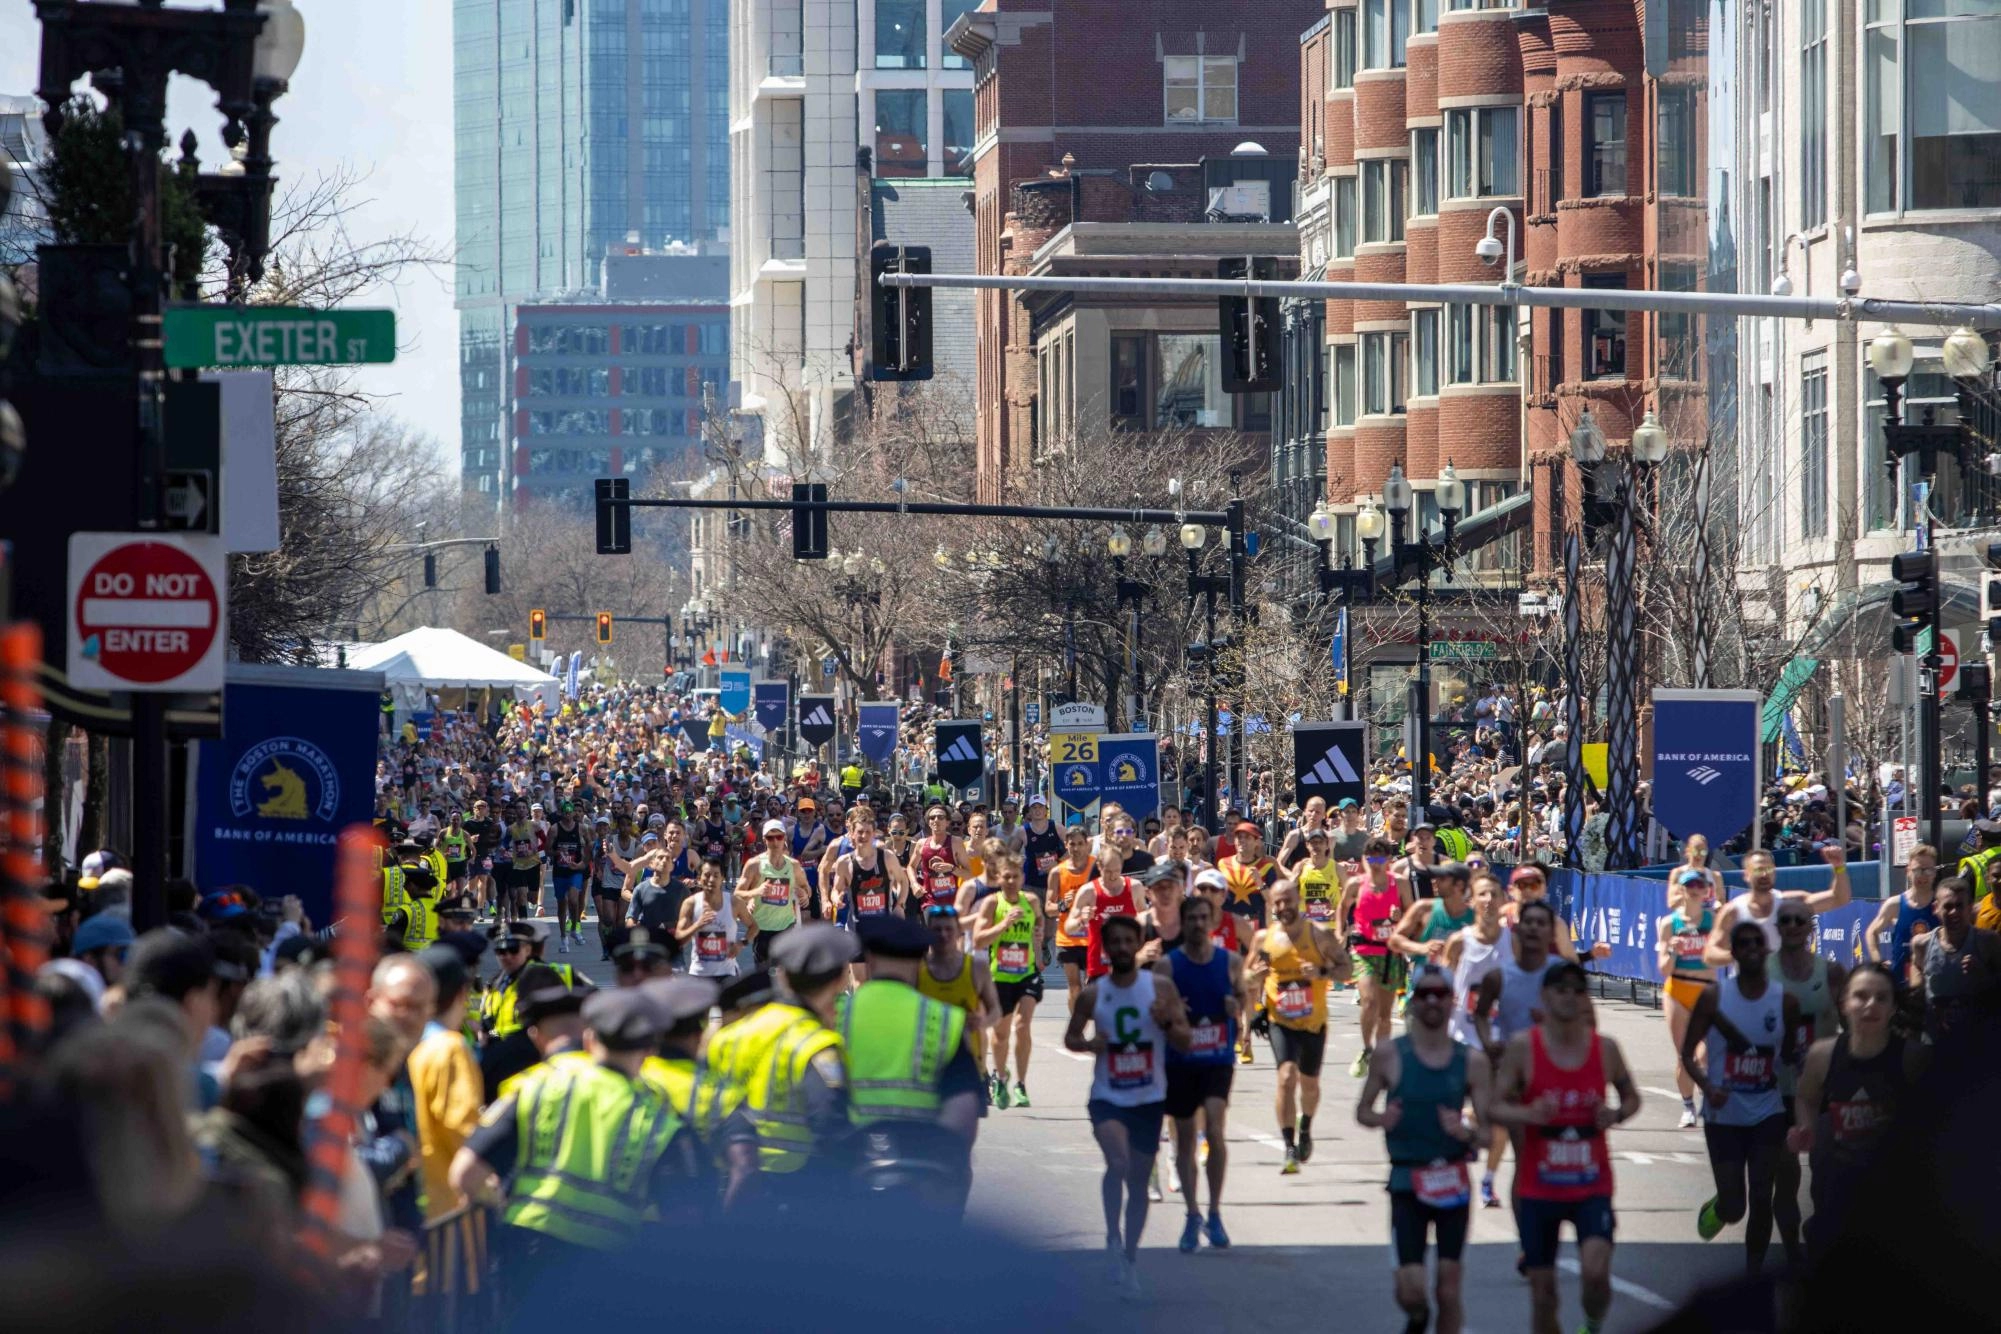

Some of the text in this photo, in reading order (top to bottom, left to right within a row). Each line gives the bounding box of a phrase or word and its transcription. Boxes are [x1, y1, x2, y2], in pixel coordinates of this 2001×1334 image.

[214, 320, 367, 362] EXETER ST
[95, 573, 200, 597] DO NOT
[105, 629, 189, 653] ENTER
[1058, 705, 1095, 716] BOSTON
[1067, 735, 1088, 743] Mile
[1062, 742, 1094, 761] 26
[1657, 753, 1751, 762] BANK OF AMERICA
[241, 741, 290, 773] BOSTON
[295, 744, 337, 811] MARATHON
[214, 828, 337, 845] BANK OF AMERICA
[1104, 904, 1124, 913] JOLLY
[1115, 1006, 1141, 1042] C
